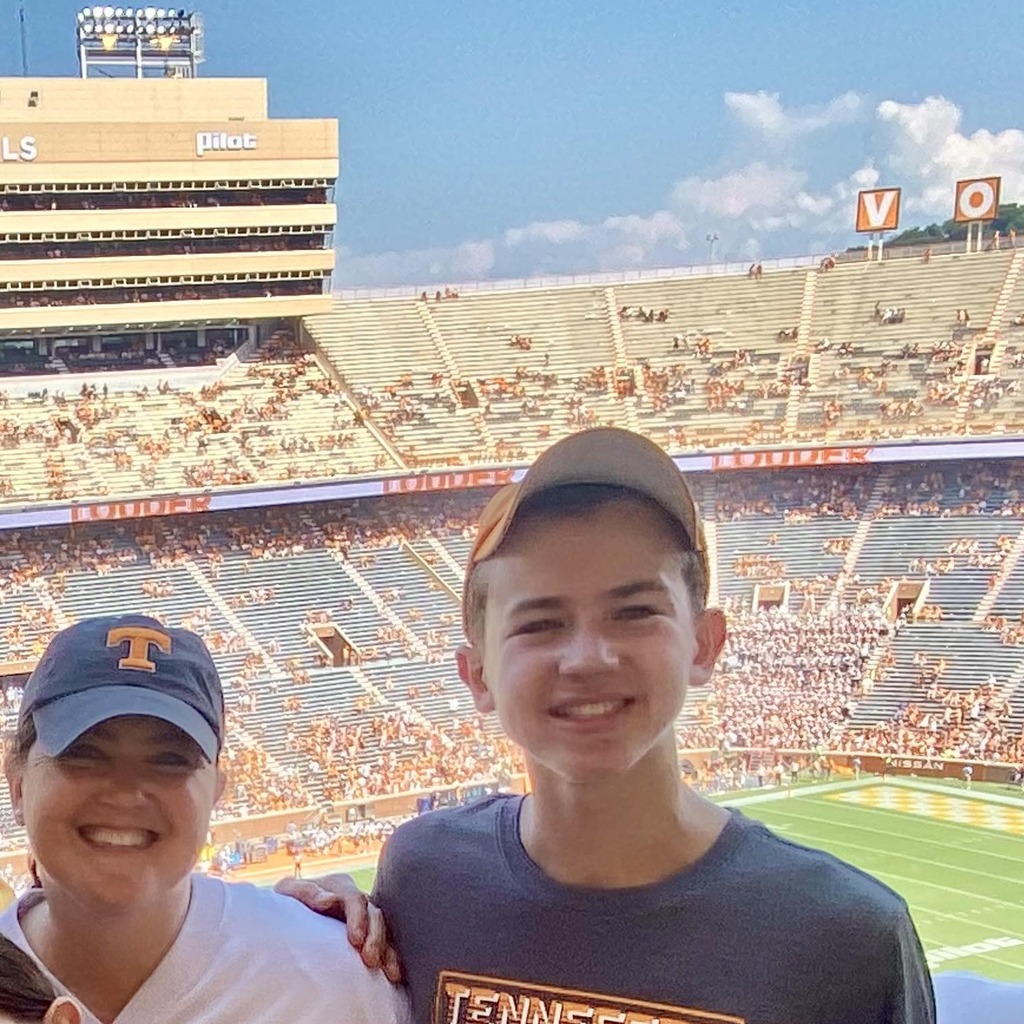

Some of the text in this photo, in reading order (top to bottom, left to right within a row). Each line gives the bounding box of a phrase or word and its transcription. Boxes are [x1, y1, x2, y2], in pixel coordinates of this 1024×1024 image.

[862, 190, 896, 227] V
[959, 182, 994, 218] O
[71, 495, 212, 523] LOUDER
[106, 626, 172, 673] T
[890, 758, 945, 771] NISSAN
